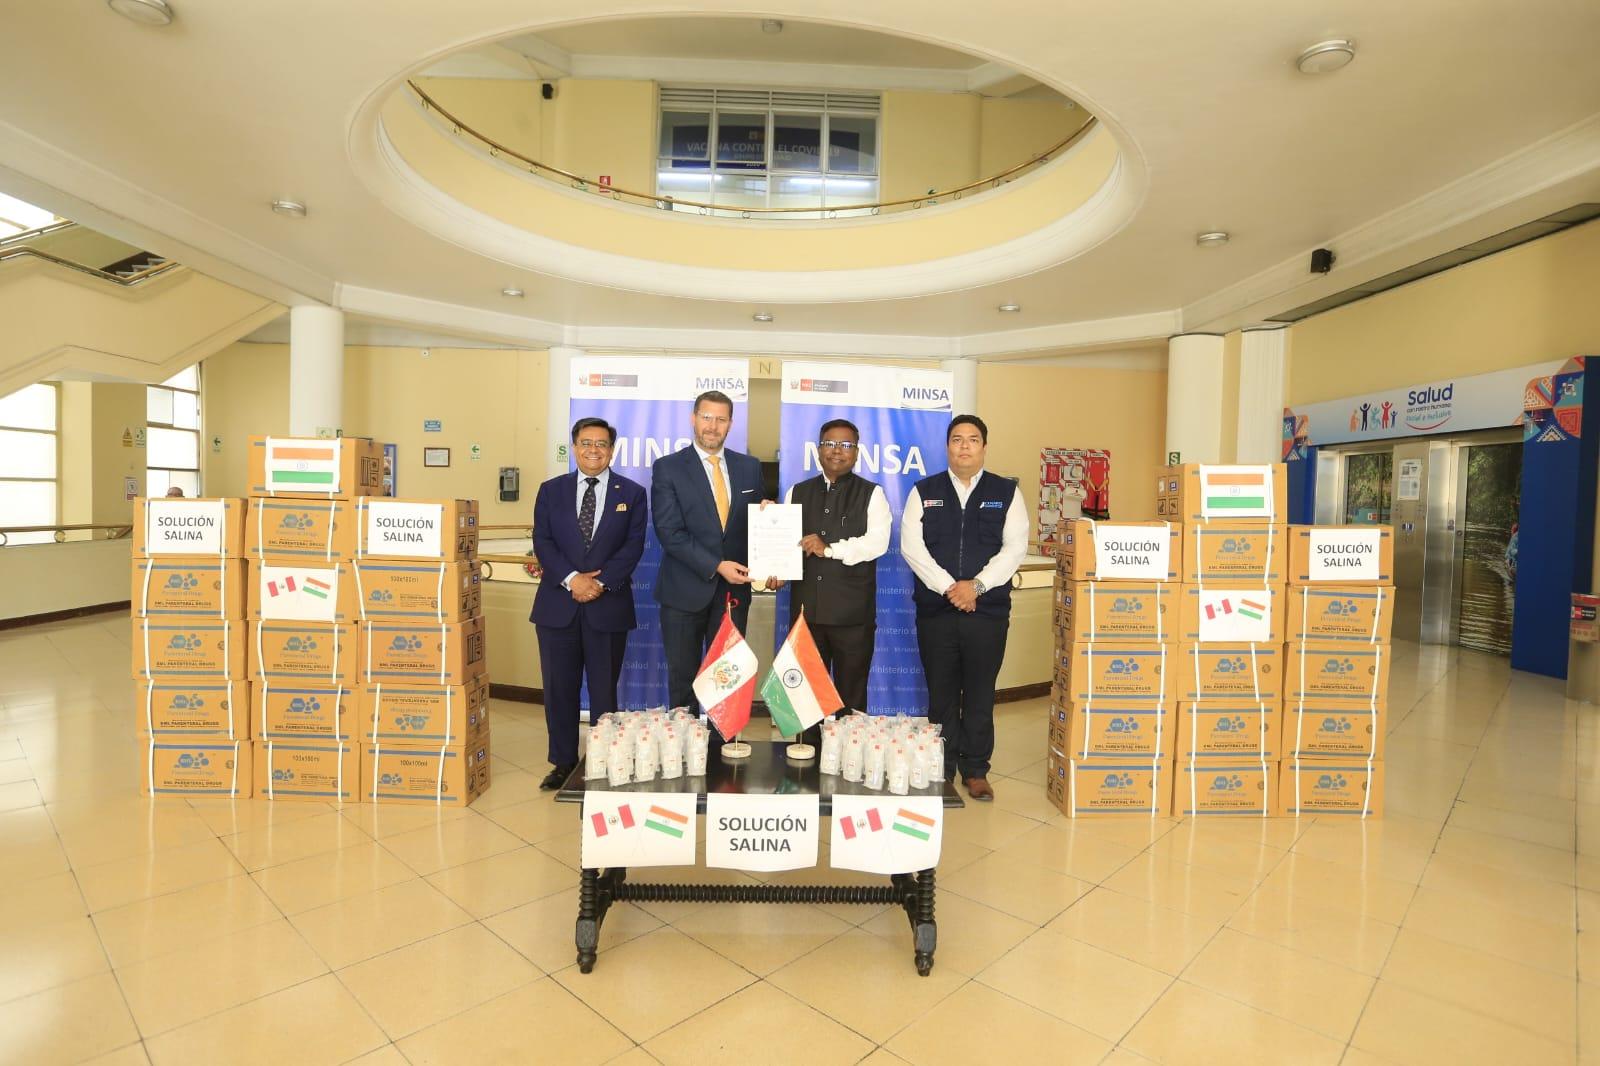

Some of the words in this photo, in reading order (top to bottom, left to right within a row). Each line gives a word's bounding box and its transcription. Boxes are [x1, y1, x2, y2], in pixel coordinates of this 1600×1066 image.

[695, 377, 745, 390] MINSA
[903, 387, 950, 401] MINSA
[1407, 383, 1453, 406] Salud
[558, 445, 567, 456] S
[804, 441, 927, 477] MNSA
[1170, 453, 1179, 464] S
[157, 514, 215, 528] SOLUCIÓN
[376, 515, 434, 530] SOLUCIÓN
[164, 529, 204, 541] SALINA
[383, 531, 425, 543] SALINA
[1104, 538, 1161, 552] SOLUCIÓN
[1317, 541, 1374, 554] SOLUCIÓN
[1111, 554, 1151, 566] SALINA
[1323, 557, 1363, 568] SALINA
[718, 814, 808, 832] SOLUCIÓN
[729, 838, 792, 852] SALINA
